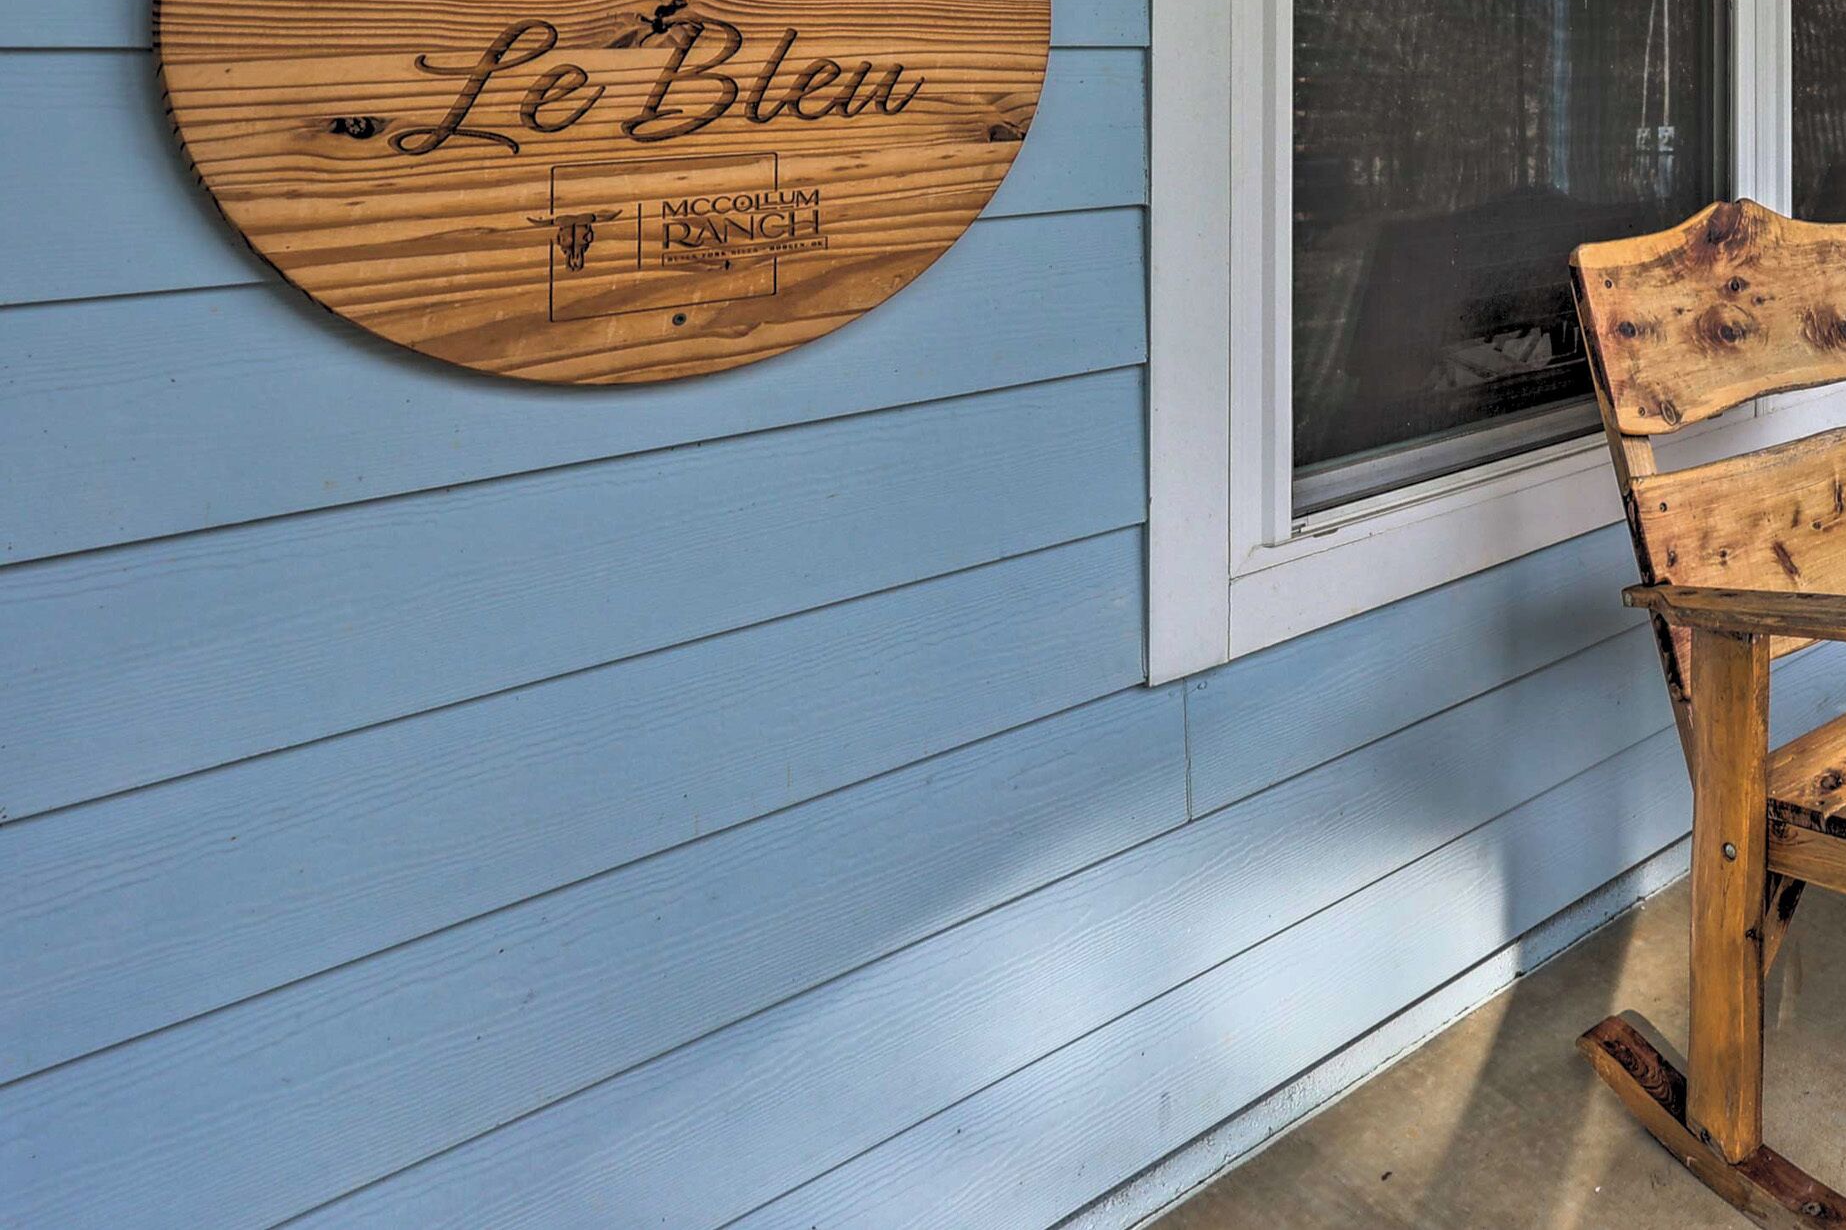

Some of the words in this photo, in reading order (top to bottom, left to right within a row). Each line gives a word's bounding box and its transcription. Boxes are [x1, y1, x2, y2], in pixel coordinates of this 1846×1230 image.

[388, 19, 608, 156] Le
[620, 20, 926, 143] Bleu
[662, 189, 819, 219] MCCOLLUM
[662, 209, 819, 249] RANCH
